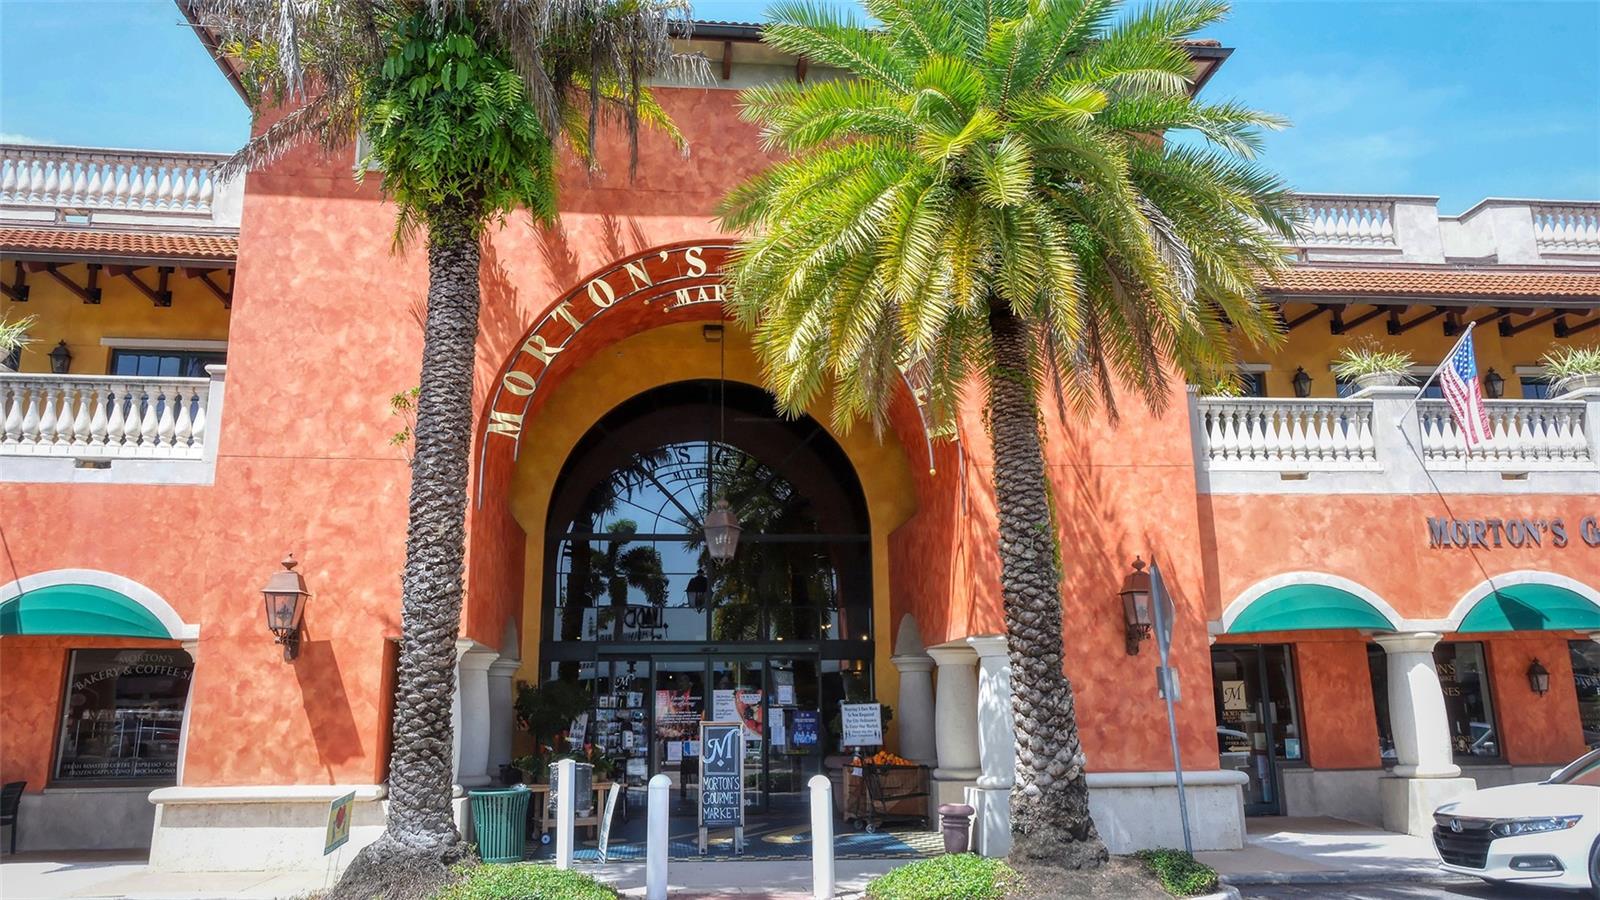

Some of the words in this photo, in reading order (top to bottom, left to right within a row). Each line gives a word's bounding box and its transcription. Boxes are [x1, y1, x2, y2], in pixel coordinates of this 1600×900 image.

[674, 283, 728, 307] MAR
[487, 246, 707, 440] MORTON'S
[1427, 516, 1568, 550] MORTON'S
[119, 654, 173, 665] MORTON'S
[76, 668, 120, 690] BAKERY
[123, 665, 132, 675] &
[135, 664, 180, 677] COFFEE
[702, 729, 743, 763] M
[703, 777, 740, 791] MORTON'S
[702, 792, 740, 805] GOURMET
